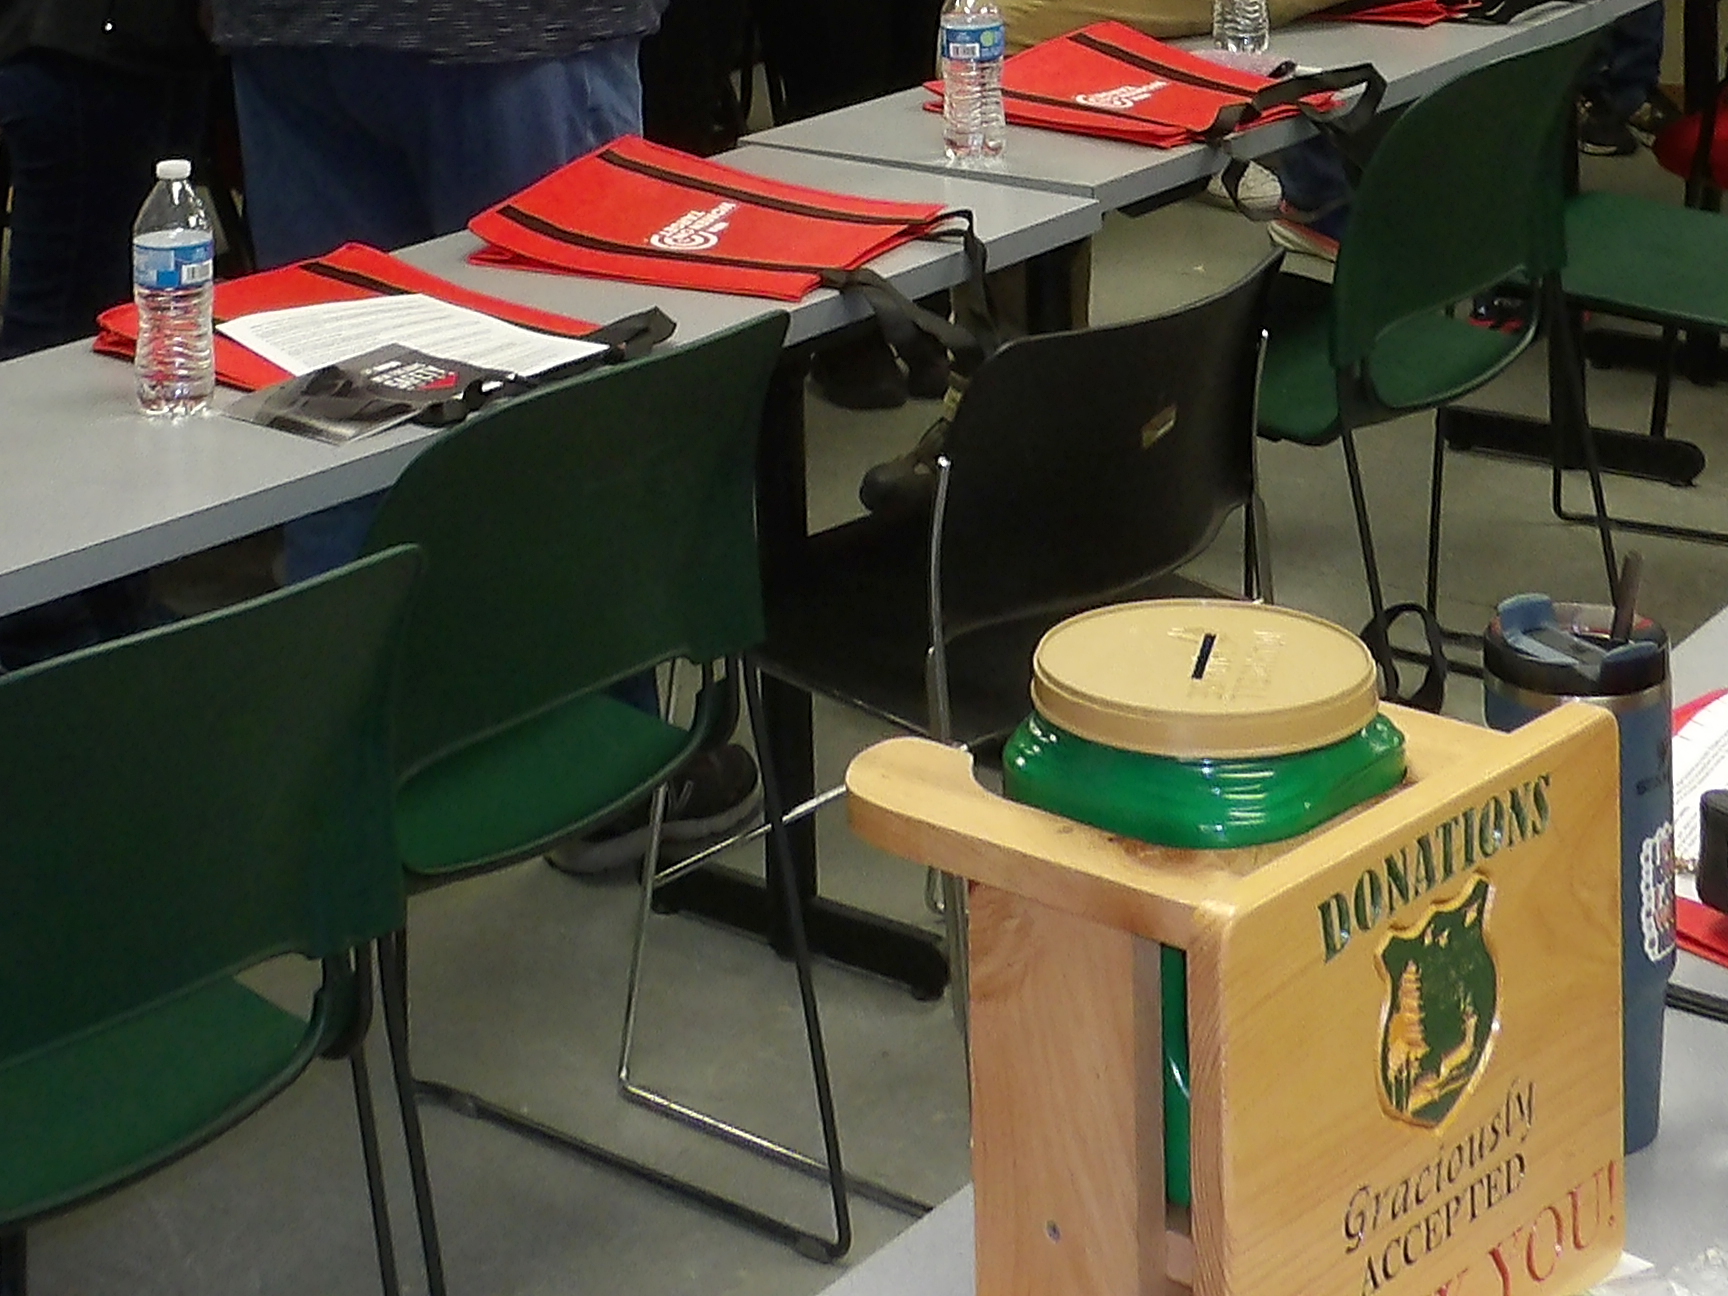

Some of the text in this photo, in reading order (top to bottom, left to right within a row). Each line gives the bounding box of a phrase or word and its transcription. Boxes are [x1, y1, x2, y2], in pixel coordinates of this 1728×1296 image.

[1317, 771, 1551, 964] DONATIONS
[1344, 1076, 1535, 1254] Graciously
[1360, 1152, 1526, 1296] ACCEPTED
[1488, 1160, 1617, 1296] YOU!
